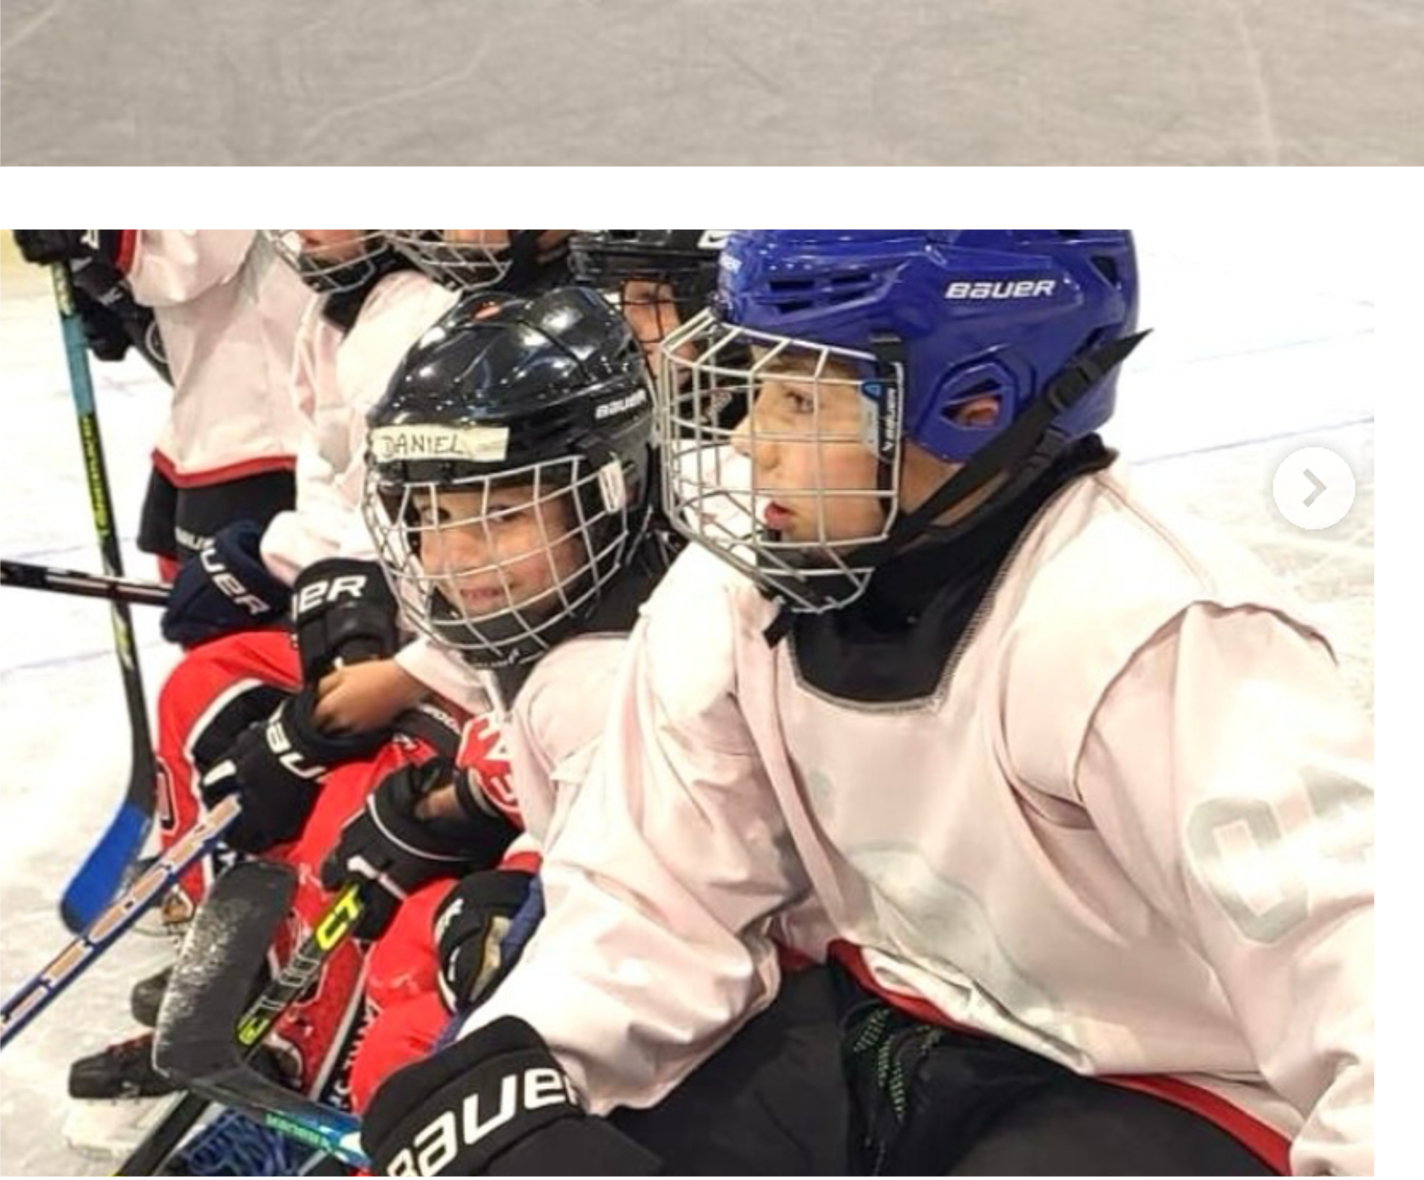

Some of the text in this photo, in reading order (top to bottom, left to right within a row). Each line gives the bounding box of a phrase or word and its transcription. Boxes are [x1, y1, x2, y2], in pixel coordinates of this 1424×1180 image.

[943, 279, 1056, 300] BAUER
[376, 434, 465, 459] DANIEL
[292, 575, 367, 621] ER
